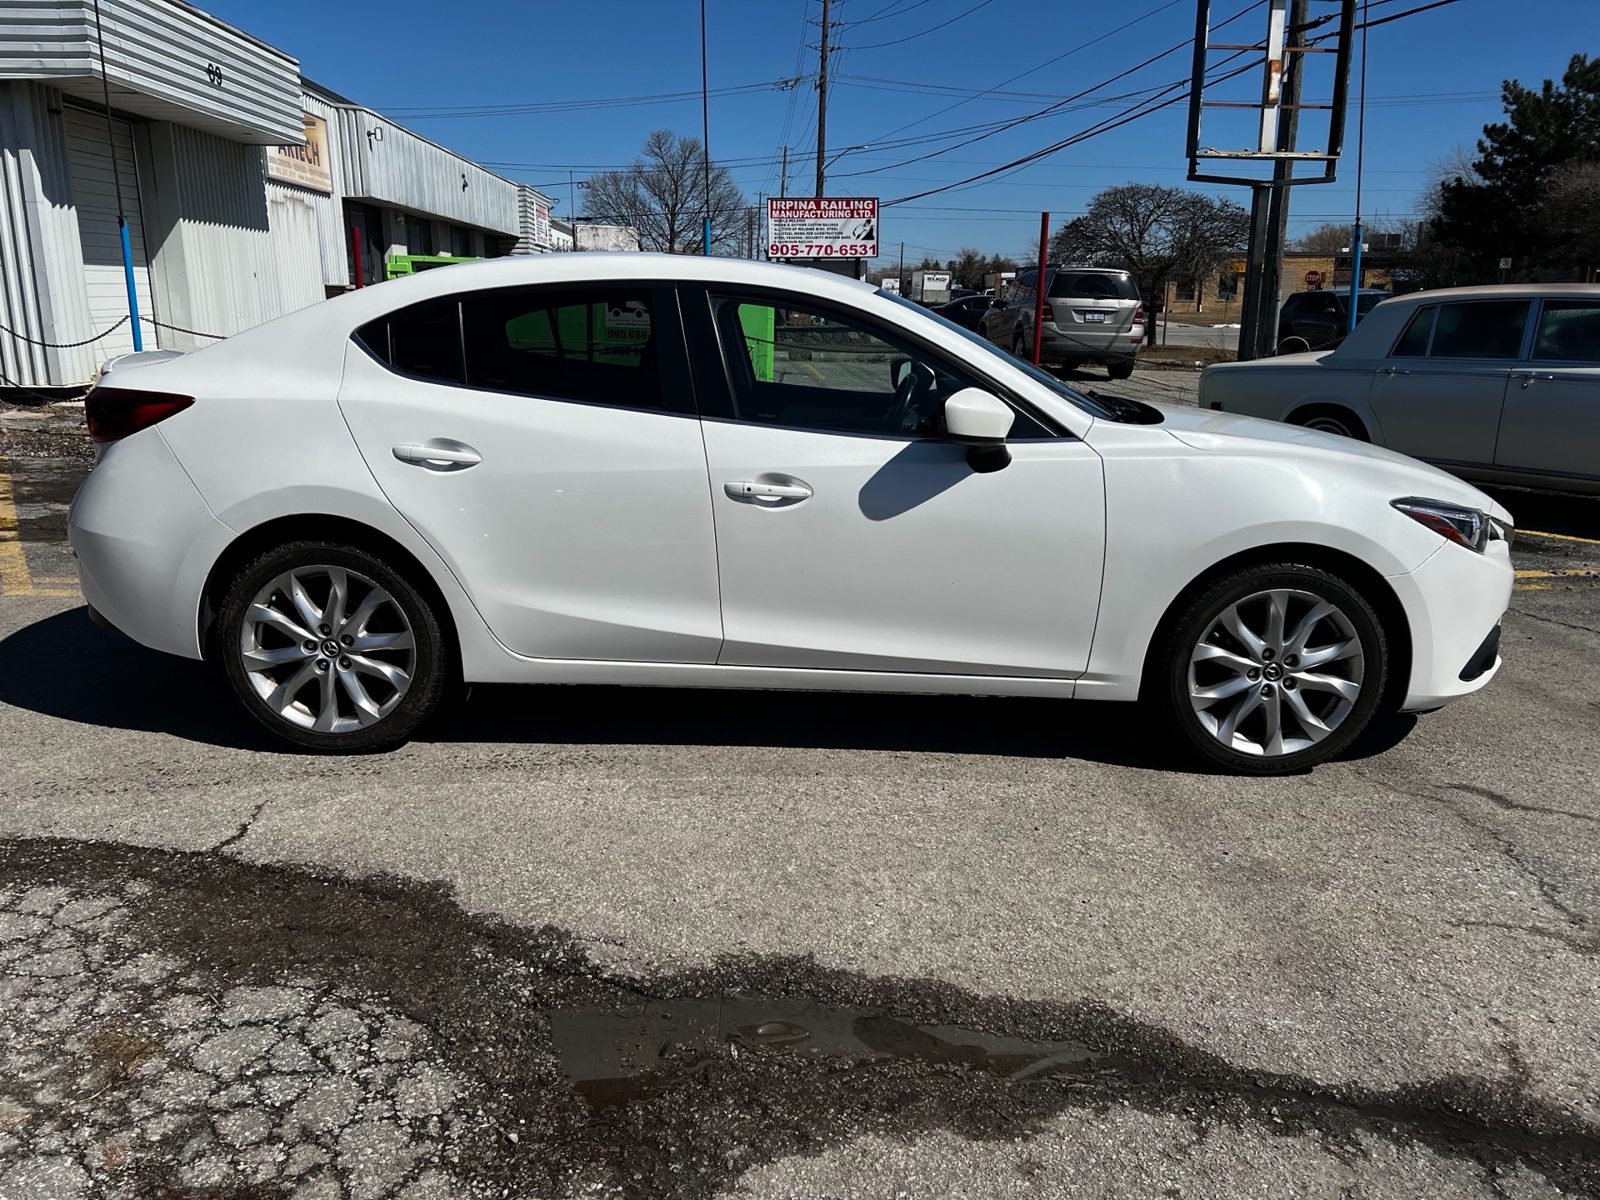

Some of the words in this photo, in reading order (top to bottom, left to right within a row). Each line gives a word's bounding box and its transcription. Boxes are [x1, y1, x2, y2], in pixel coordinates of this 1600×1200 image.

[208, 62, 222, 86] 69
[772, 200, 817, 210] IRPINA
[820, 200, 873, 210] RAILING
[772, 210, 852, 218] MANUFACTURING
[854, 210, 874, 218] LTD.
[770, 244, 876, 256] 905-770-6531
